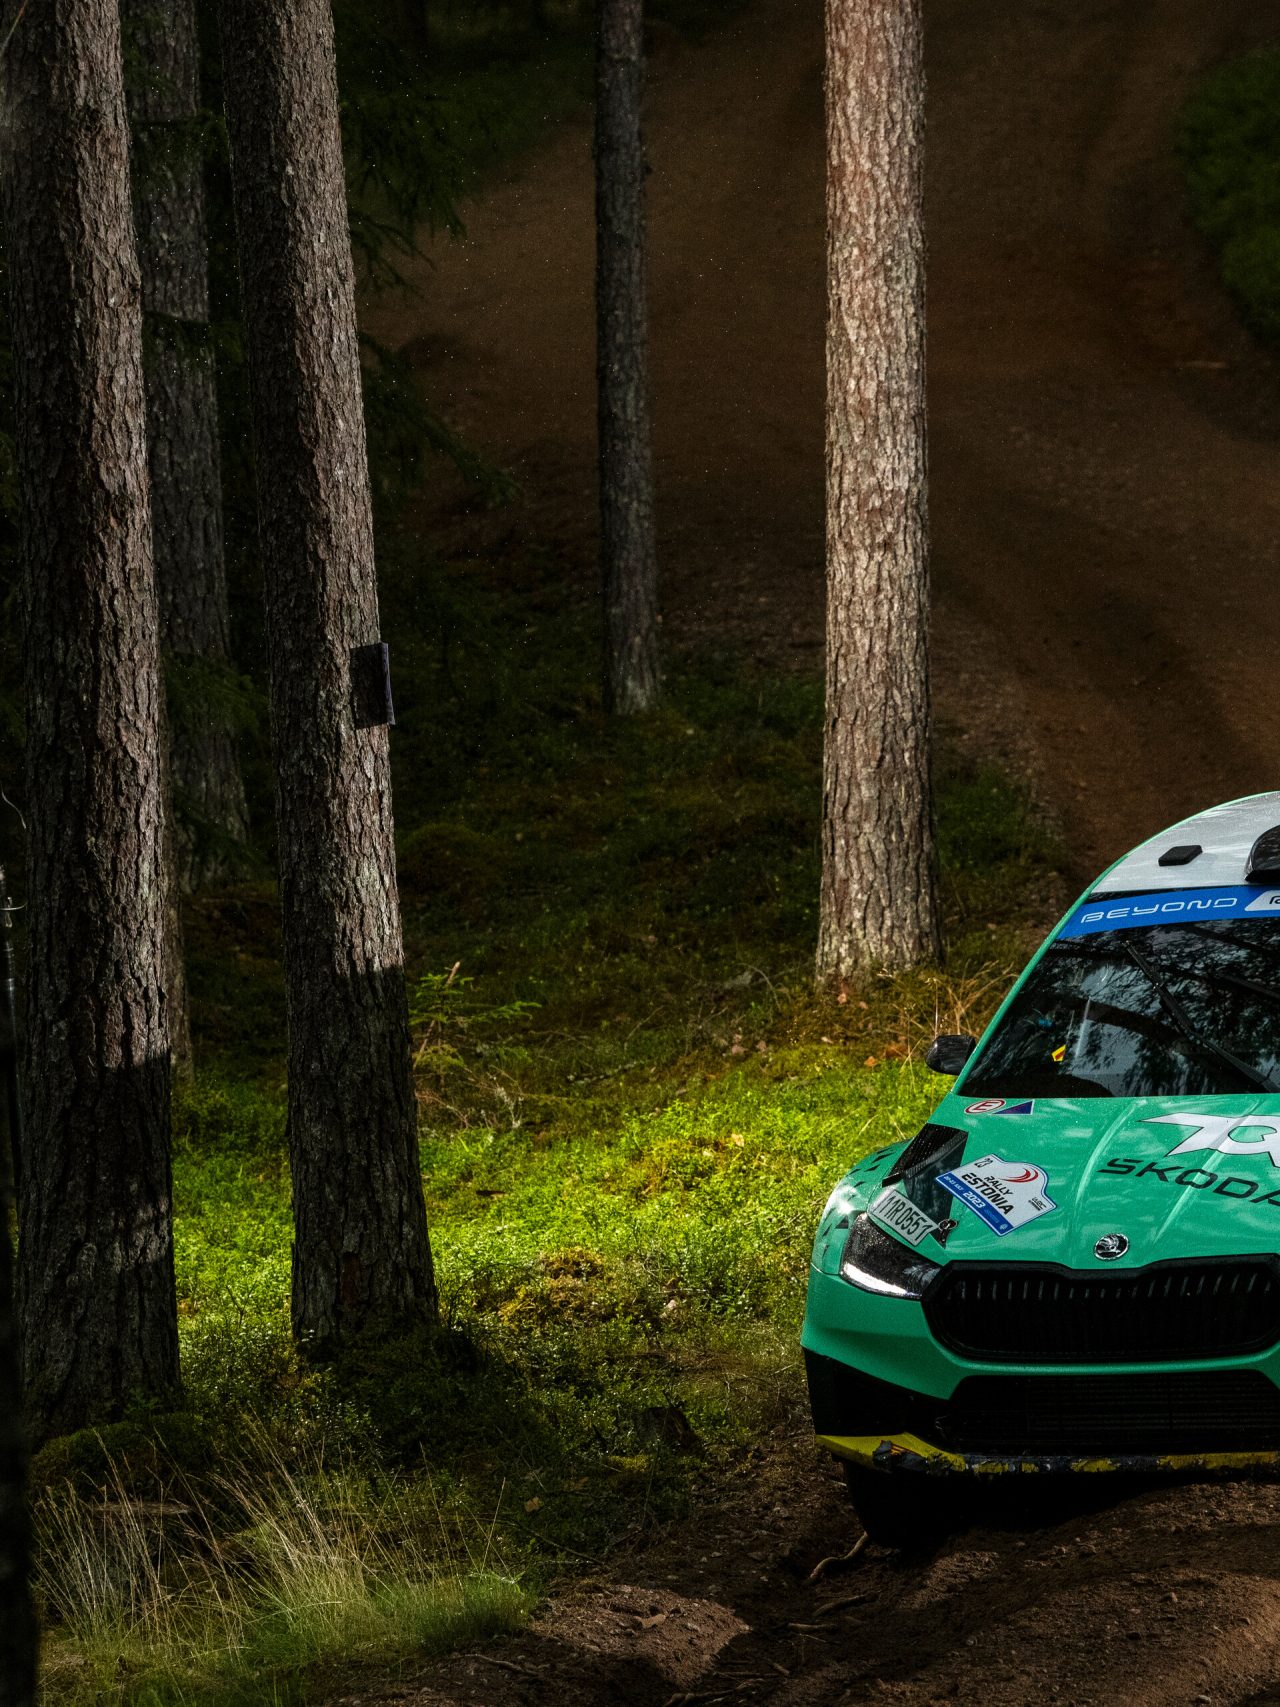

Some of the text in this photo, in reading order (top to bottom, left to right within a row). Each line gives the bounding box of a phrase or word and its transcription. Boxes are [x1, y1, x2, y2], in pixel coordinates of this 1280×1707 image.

[1081, 897, 1237, 924] BEYOND
[974, 1157, 994, 1169] 23
[961, 1172, 1015, 1215] ESTONIA
[983, 1175, 1014, 1196] RALLY
[962, 1190, 986, 1209] 2023
